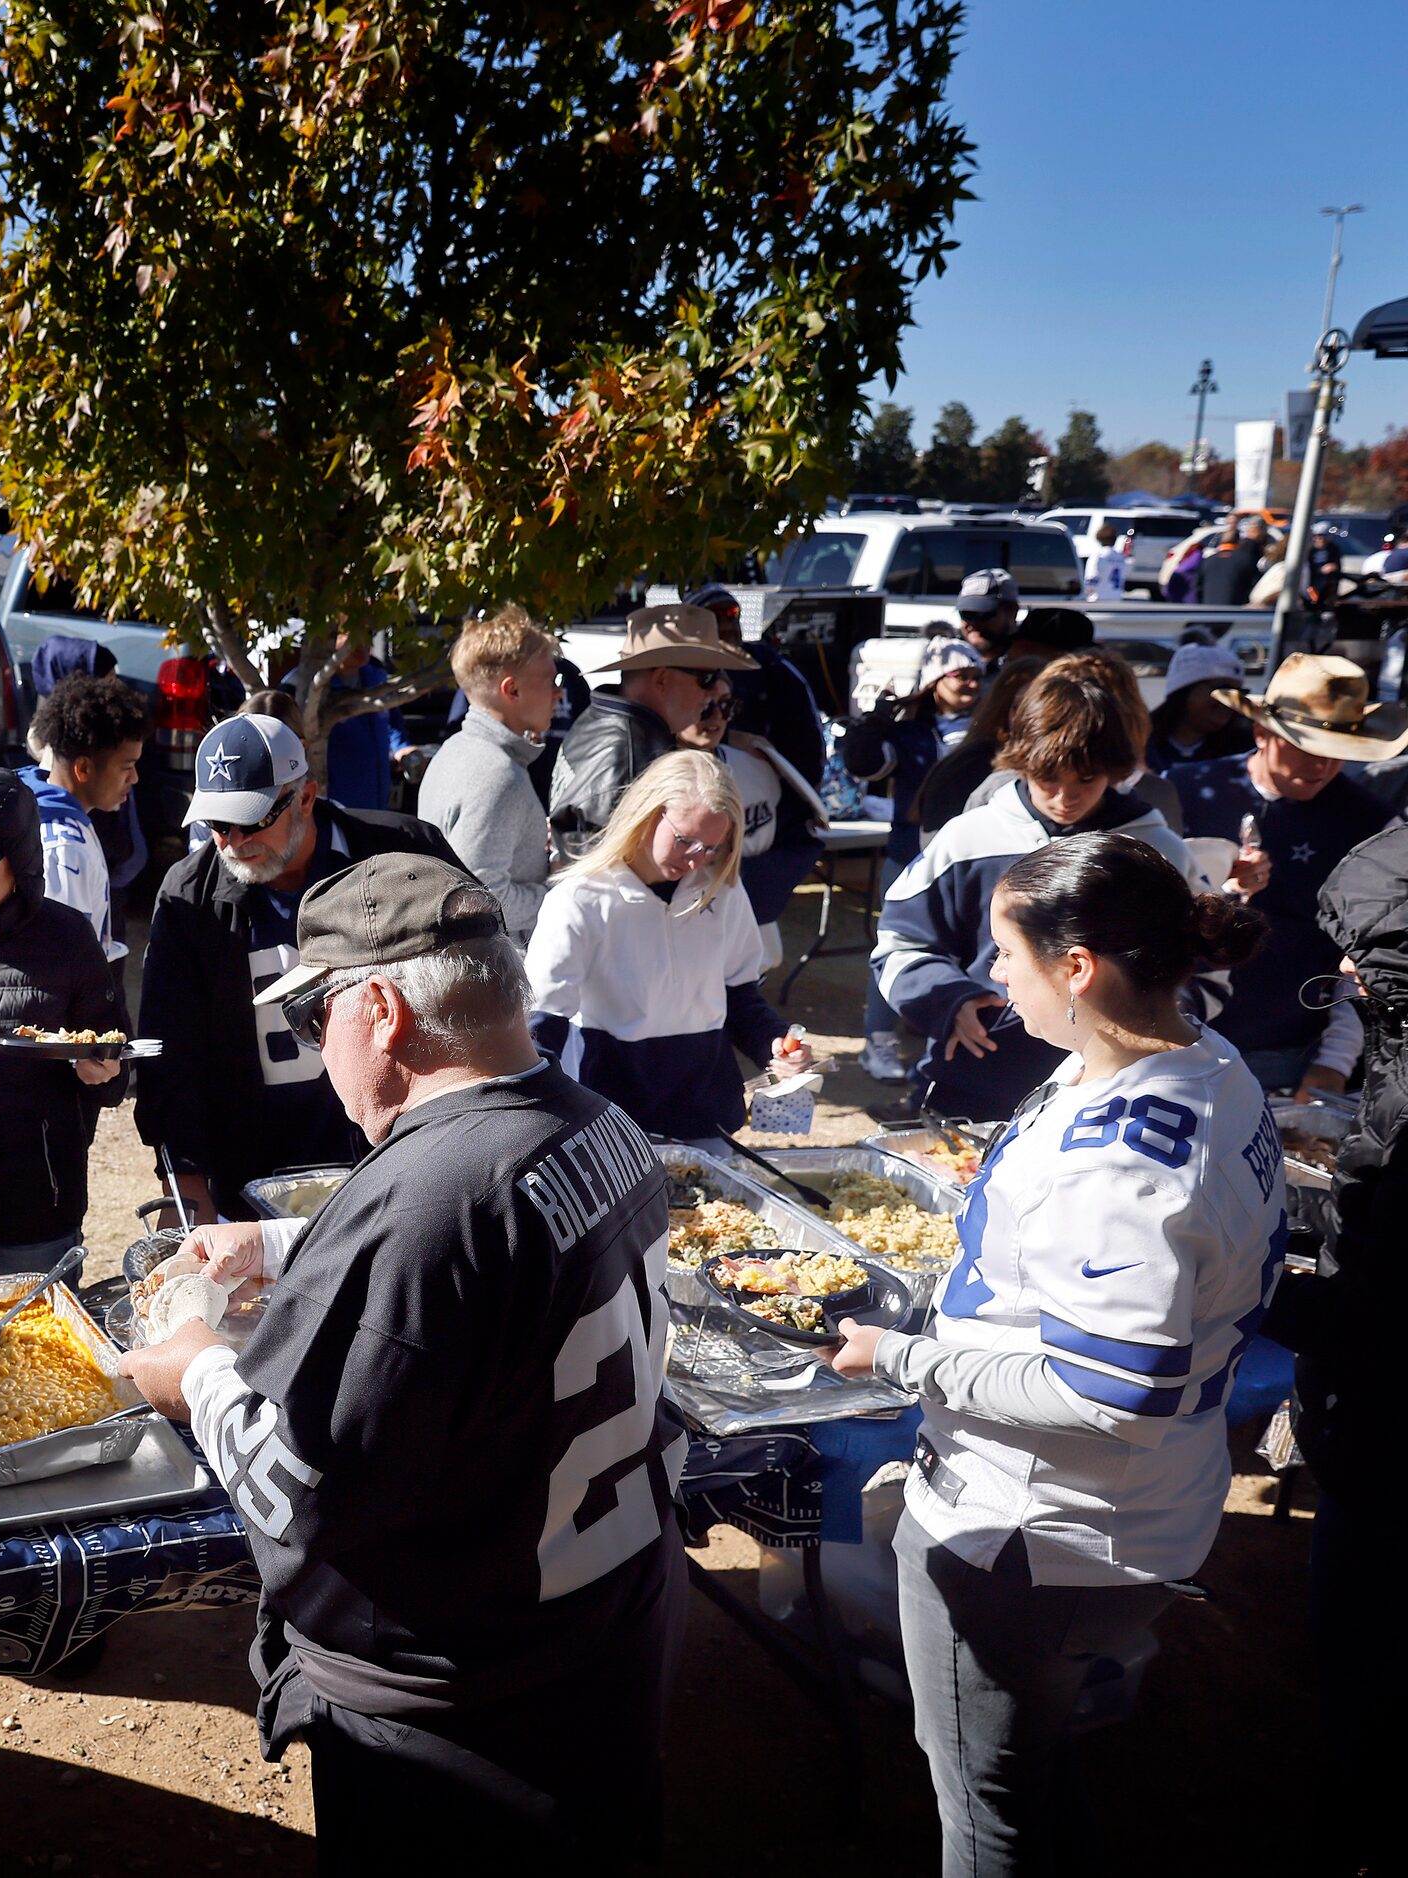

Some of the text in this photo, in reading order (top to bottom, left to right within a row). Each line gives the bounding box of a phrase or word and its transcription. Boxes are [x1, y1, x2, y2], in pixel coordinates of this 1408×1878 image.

[1059, 1094, 1198, 1169] 88
[220, 1397, 324, 1540] 25
[537, 1228, 689, 1603] 2
